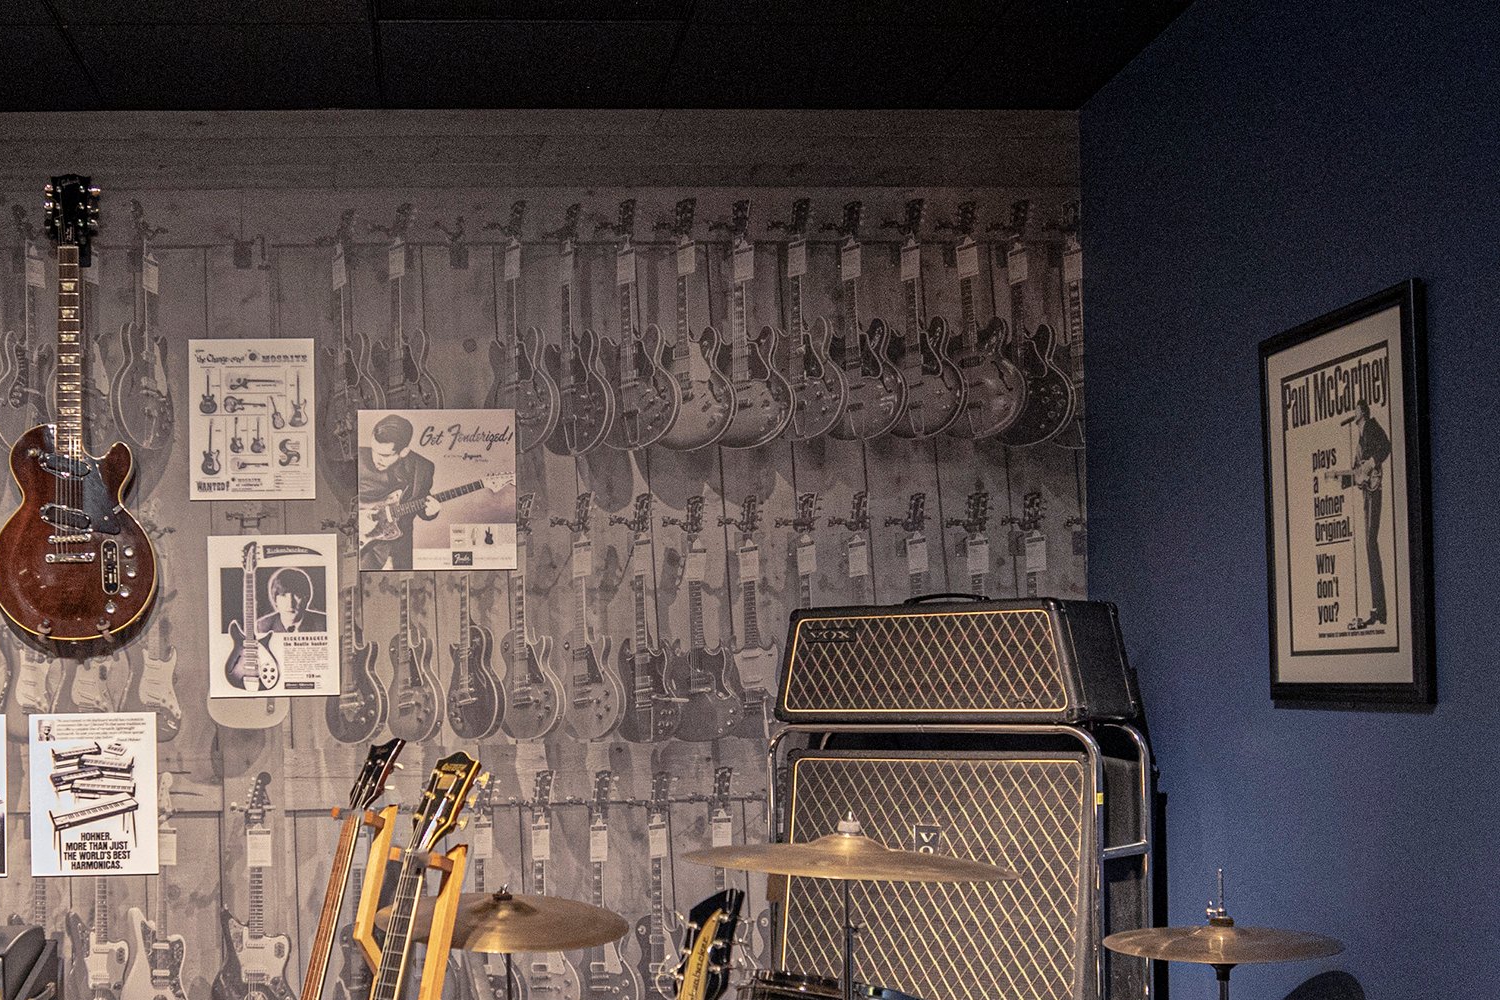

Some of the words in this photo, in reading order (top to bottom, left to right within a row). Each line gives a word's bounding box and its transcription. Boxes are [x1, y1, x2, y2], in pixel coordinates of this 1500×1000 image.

[1284, 377, 1311, 431] Paul
[1313, 356, 1389, 422] McCartney
[419, 425, 444, 447] Get
[447, 423, 514, 451] Fenderized!
[1312, 448, 1337, 472] plays
[1313, 476, 1319, 494] a
[1315, 516, 1353, 542] Original.
[1316, 553, 1336, 574] Why
[1317, 576, 1340, 599] don't
[1318, 601, 1340, 626] you?
[808, 630, 850, 640] VOX
[65, 842, 87, 851] MORE
[89, 842, 108, 851] THAN
[109, 841, 128, 850] JUST
[80, 832, 112, 841] HOHNER.
[63, 852, 77, 860] THE
[79, 851, 111, 860] WORLD'S
[113, 851, 131, 860] BEST
[71, 860, 123, 870] HARMONICAS.
